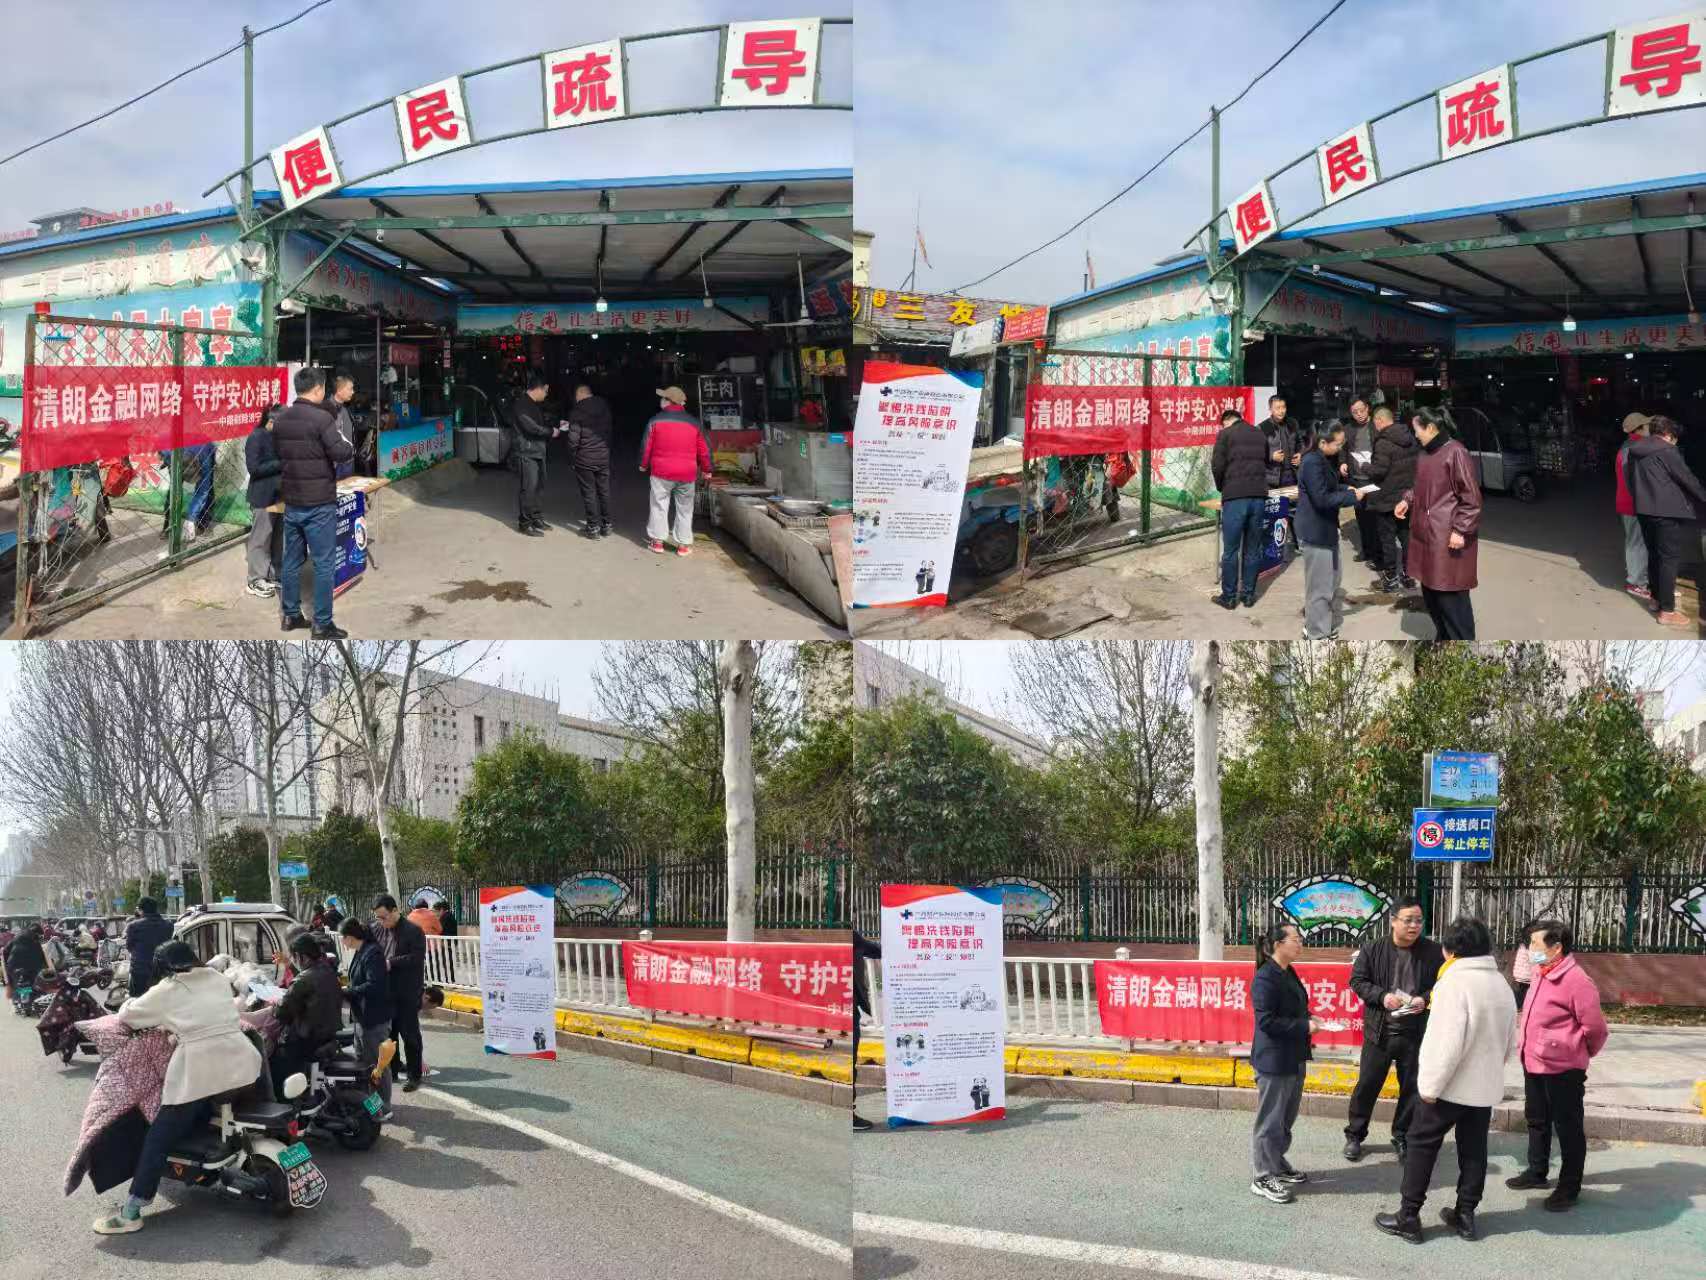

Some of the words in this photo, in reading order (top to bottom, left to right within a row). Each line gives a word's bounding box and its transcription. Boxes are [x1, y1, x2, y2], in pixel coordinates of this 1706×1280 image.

[33, 382, 183, 429] 清朗金融网络
[193, 378, 281, 413] 守护安心消费
[703, 380, 734, 398] 牛肉
[1031, 397, 1151, 430] 清朗金融网络
[1444, 818, 1491, 832] 接送岗口
[1444, 837, 1490, 851] 禁止停车
[632, 952, 763, 993] 清朗金融网络
[1107, 974, 1247, 1011] 清朗金融网络
[1301, 978, 1365, 1013] 安心
